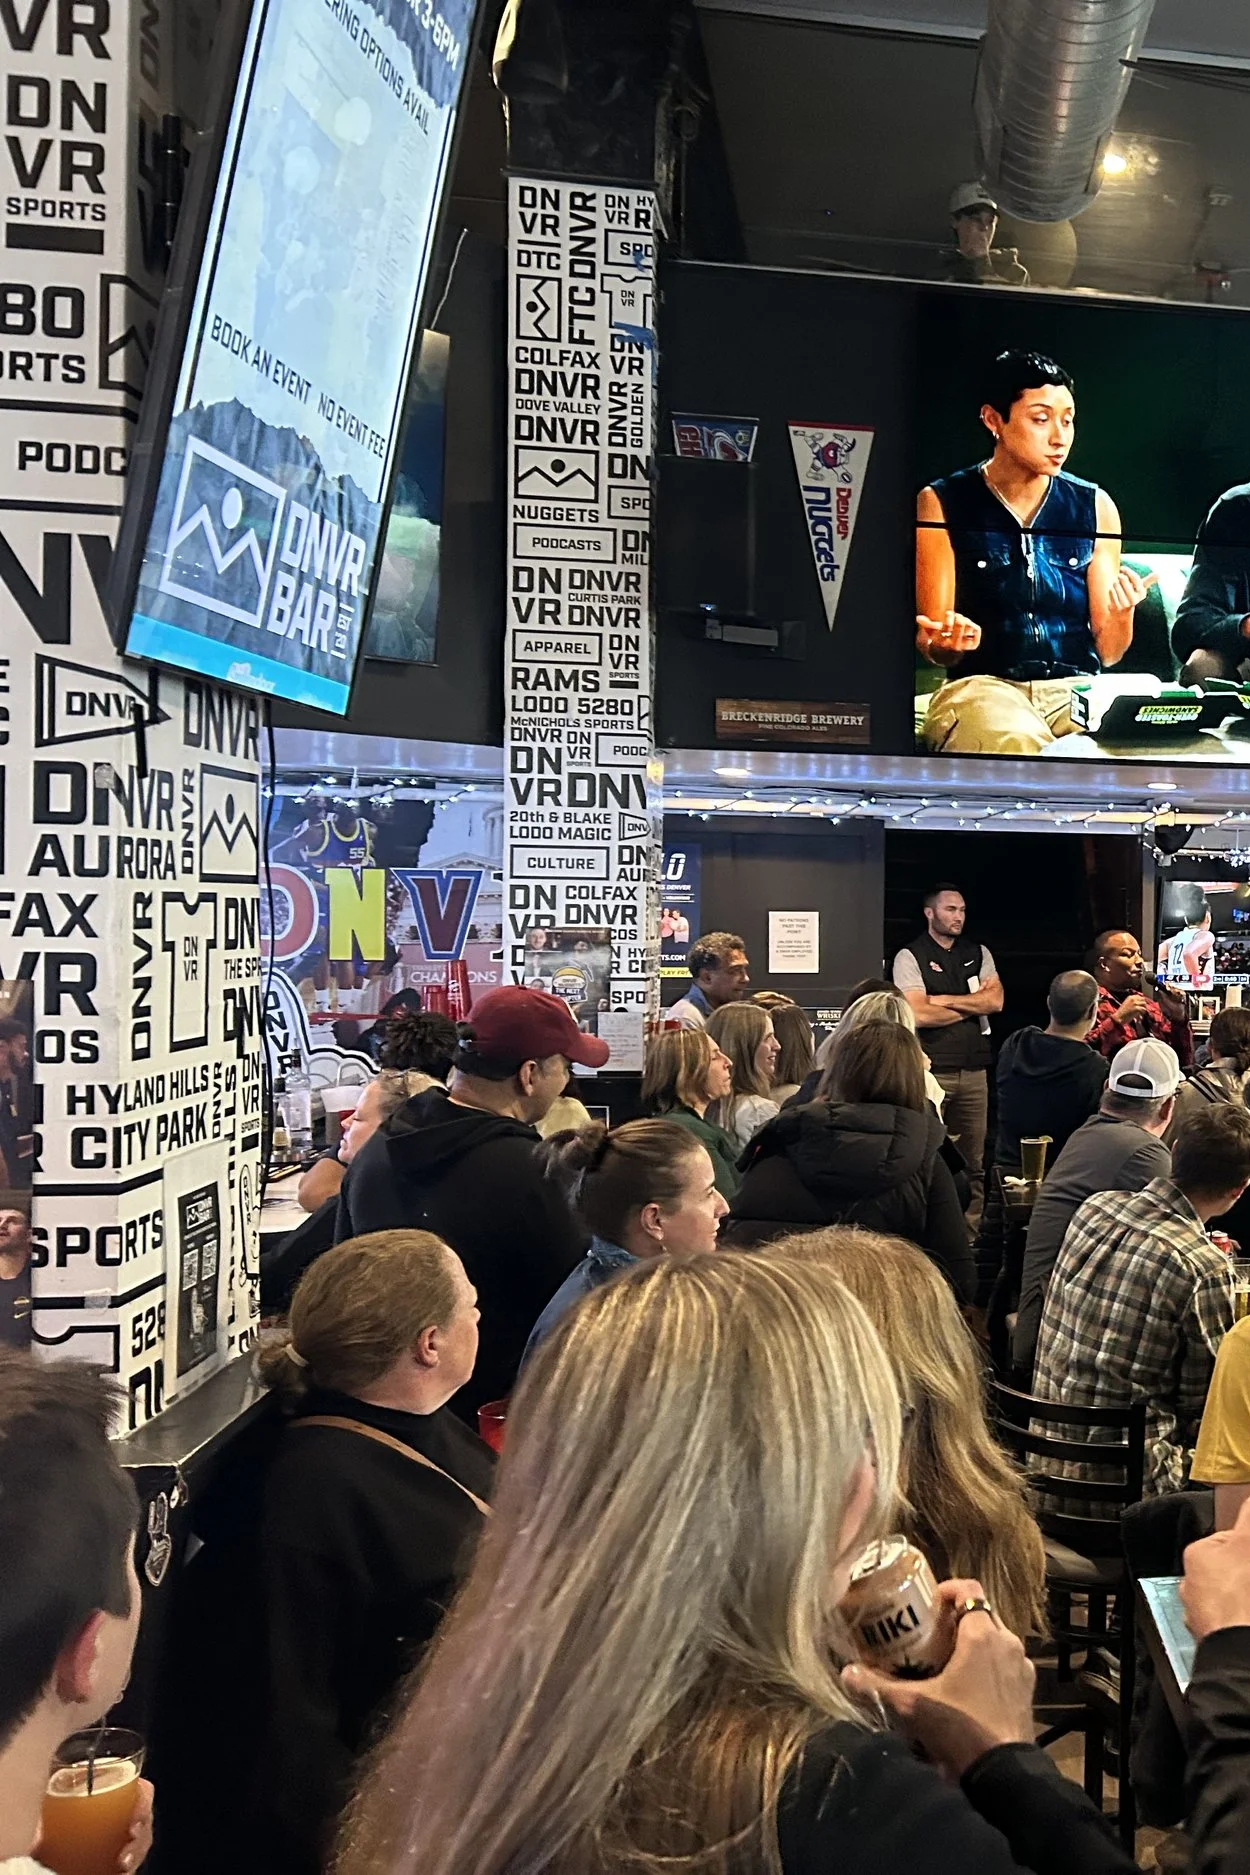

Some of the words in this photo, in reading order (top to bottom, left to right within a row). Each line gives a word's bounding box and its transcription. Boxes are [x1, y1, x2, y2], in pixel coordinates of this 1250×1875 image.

[360, 28, 404, 99] OPTIONS
[403, 88, 430, 135] AVAIL
[7, 74, 107, 134] DN
[5, 136, 106, 194] VR
[6, 197, 106, 222] SPORTS
[519, 185, 560, 211] DN
[519, 211, 560, 237] VR
[569, 191, 596, 280] DNVR
[517, 249, 561, 270] DTC
[568, 286, 596, 346] FTC
[515, 346, 601, 369] COLFAX
[211, 314, 252, 363] BOOK
[251, 346, 272, 377] AN
[272, 359, 312, 404] EVENT
[318, 392, 335, 422] NO
[336, 406, 369, 450] EVENT
[368, 430, 386, 459] FEE
[515, 368, 601, 400] DNVR
[515, 398, 550, 412] DOVE
[553, 401, 601, 415] VALLEY
[630, 383, 644, 448] GOLDEN
[514, 414, 600, 446] DNVR
[513, 504, 599, 523] NUGGETS
[280, 500, 366, 598] DNVR
[532, 537, 601, 551] PODCASTS
[512, 566, 562, 594] DN
[568, 569, 641, 593] DNVR
[267, 570, 337, 653] BAR
[512, 596, 562, 625] VR
[568, 592, 608, 604] CURTIS
[611, 594, 641, 606] PARK
[568, 604, 641, 628] DNVR
[523, 641, 591, 654] APPAREL
[609, 634, 639, 651] DN
[608, 653, 639, 670] VR
[511, 666, 600, 693] RAMS
[66, 691, 136, 718] DNVR
[511, 695, 568, 713] LODO
[577, 697, 633, 716] 5280
[183, 679, 259, 761] DNVR
[511, 716, 581, 728] McNICHOLS
[585, 719, 634, 730] SPORTS
[721, 711, 807, 724] BRECKENRIDGE
[811, 714, 865, 726] BREWERY
[511, 727, 562, 743] DNVR
[567, 731, 591, 745] DN
[510, 745, 562, 775] DN
[567, 746, 591, 759] VR
[33, 760, 175, 831] DNVR
[510, 777, 562, 806] VR
[181, 768, 195, 874] DNVR
[510, 811, 544, 823] 20th
[550, 812, 559, 823] &
[563, 812, 612, 824] BLAKE
[510, 826, 553, 839] LODO
[558, 827, 612, 840] MAGIC
[28, 833, 177, 881] AURORA
[527, 857, 595, 869] CULTURE
[509, 884, 557, 910] DN
[565, 885, 637, 901] COLFAX
[565, 903, 637, 925] DNVR
[184, 936, 198, 957] DN
[132, 891, 153, 1061] DNVR
[183, 959, 198, 981] VR
[224, 958, 243, 980] THE
[242, 1051, 260, 1083] DN
[66, 1074, 165, 1115] HYLAND
[170, 1064, 209, 1100] HILLS
[213, 1060, 223, 1139] DNVR
[242, 1083, 260, 1115] VR
[71, 1118, 150, 1169] CITY
[156, 1102, 208, 1155] PARK
[31, 1209, 163, 1268] SPORTS
